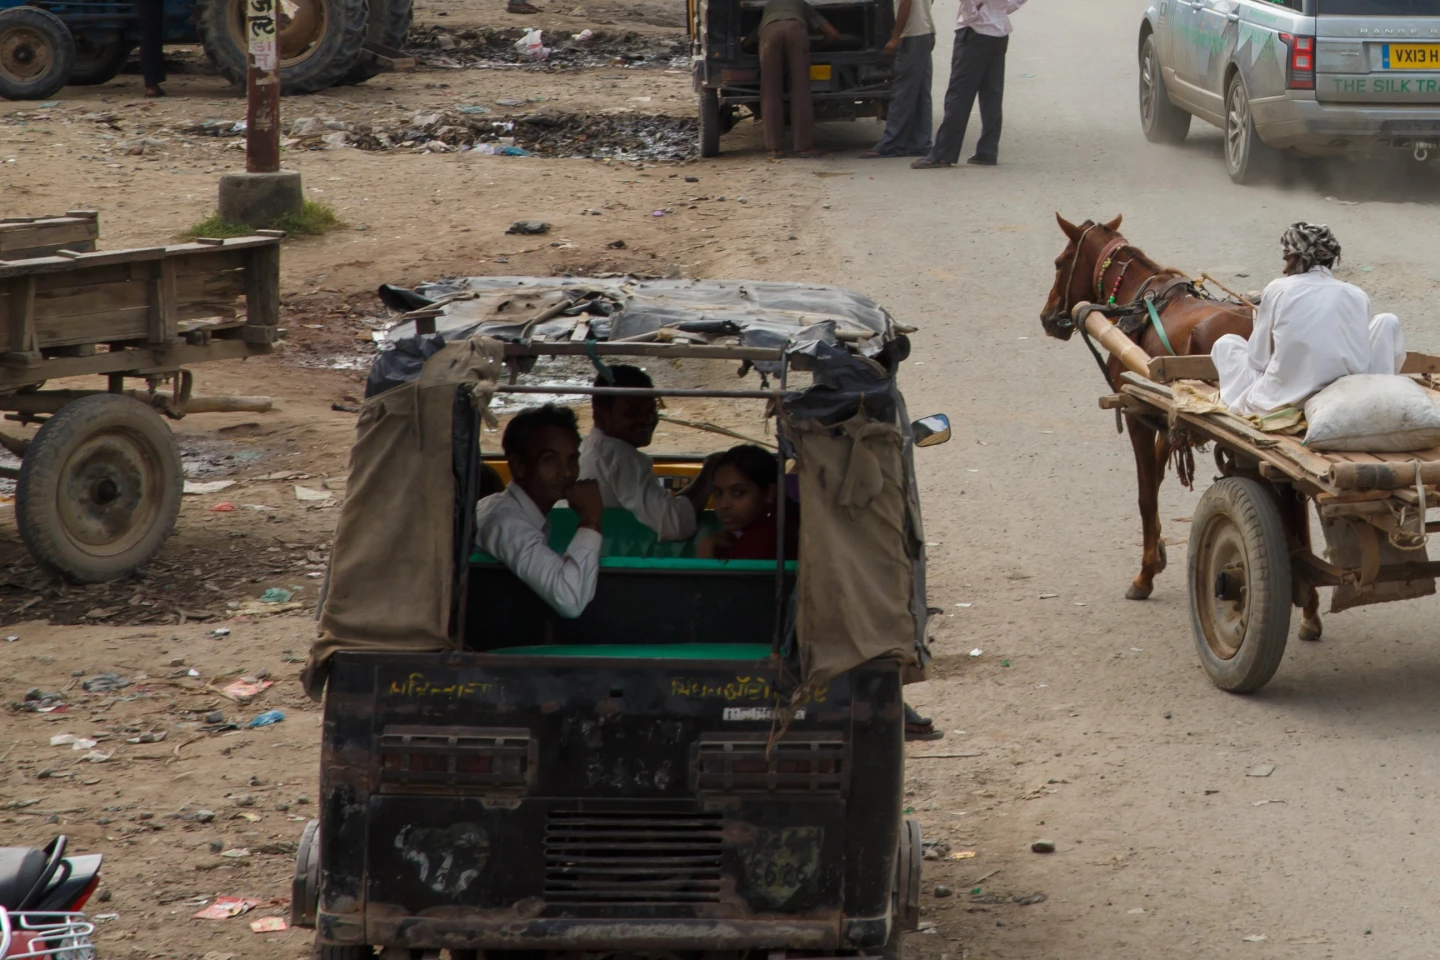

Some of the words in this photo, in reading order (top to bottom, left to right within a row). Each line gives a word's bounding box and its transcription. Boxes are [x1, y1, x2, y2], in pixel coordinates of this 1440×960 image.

[1360, 27, 1417, 35] RANGE
[1395, 49, 1426, 63] VX13
[1333, 79, 1366, 93] THE
[1373, 79, 1410, 93] SILK
